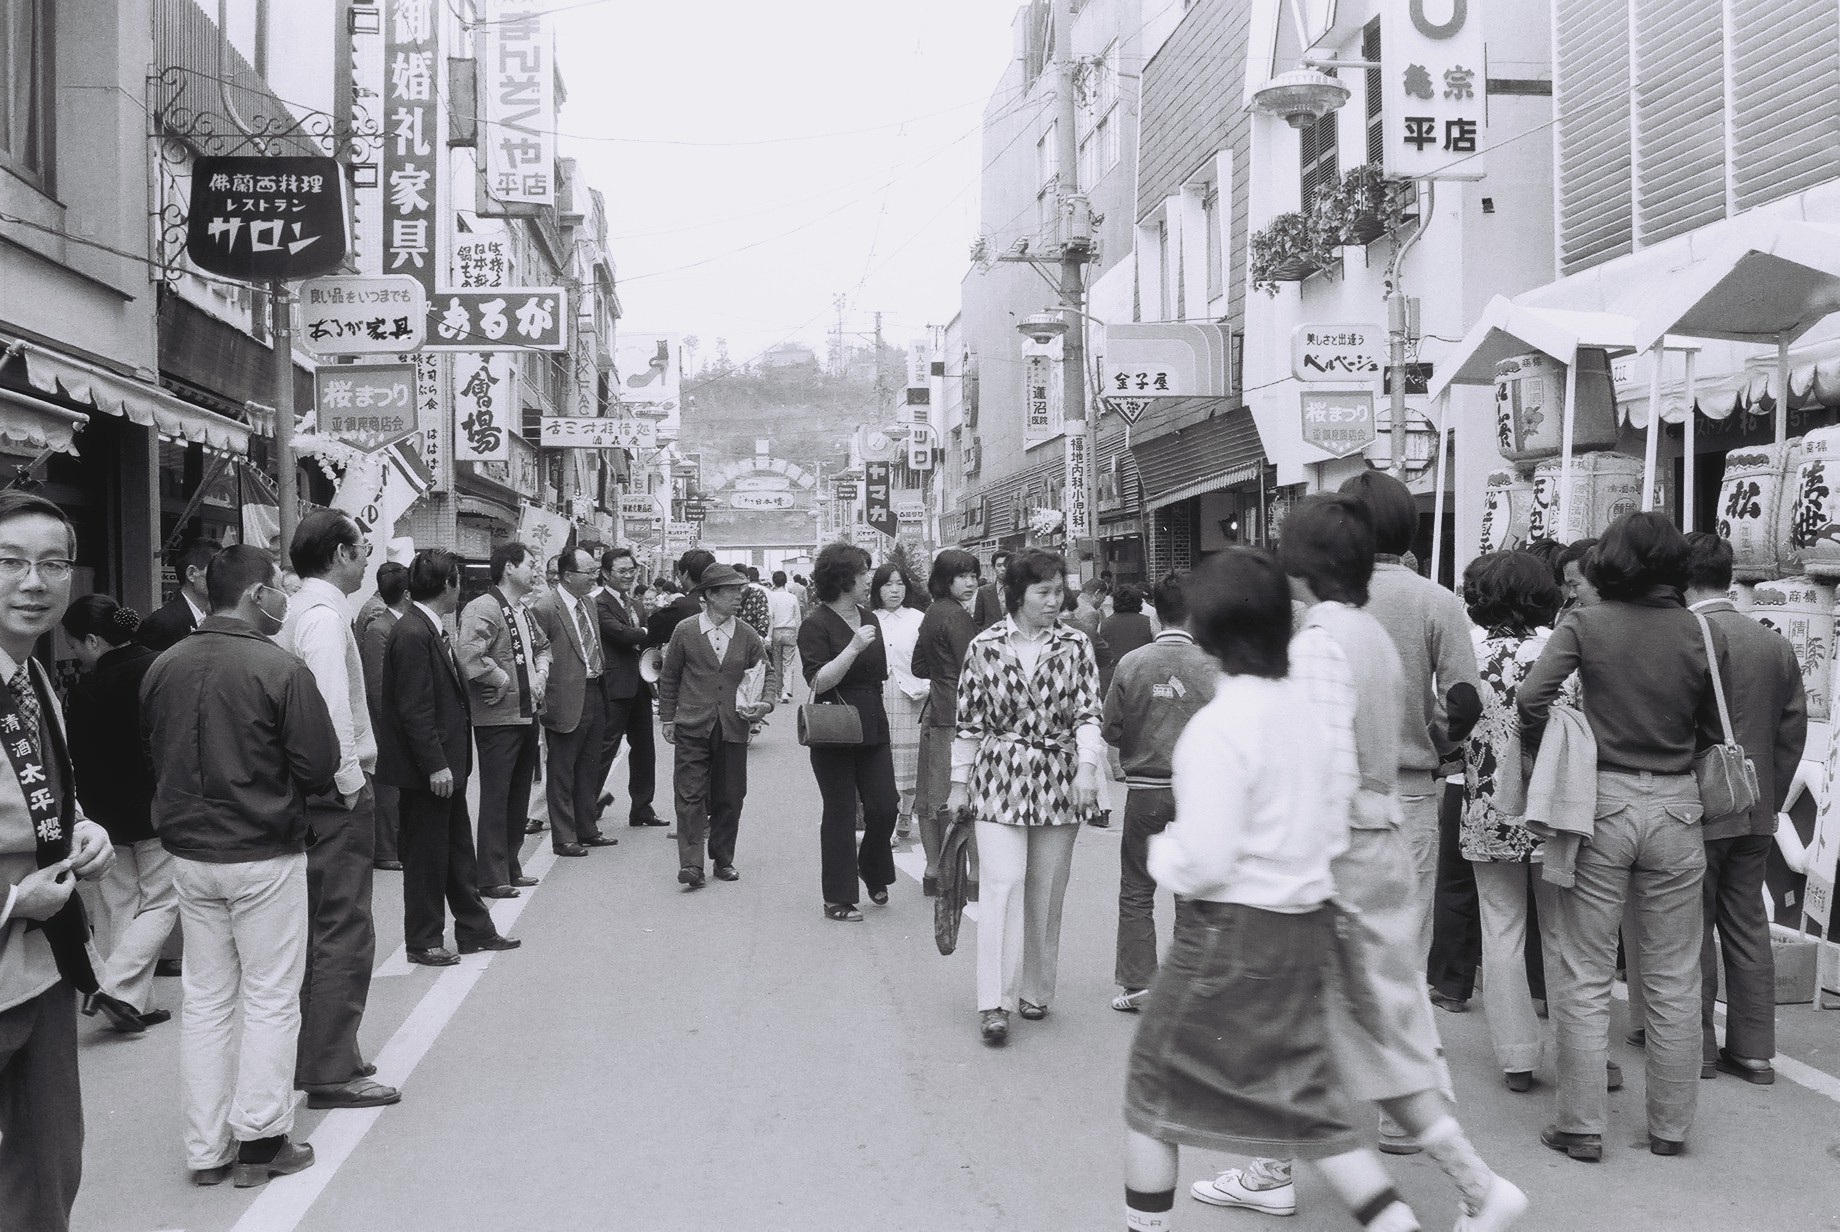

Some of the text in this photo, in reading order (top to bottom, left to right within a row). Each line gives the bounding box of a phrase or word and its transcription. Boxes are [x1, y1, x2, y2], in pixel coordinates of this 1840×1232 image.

[1403, 116, 1477, 152] 平店
[208, 173, 324, 193] 佛蘭西料理
[496, 172, 547, 196] 平店
[226, 198, 306, 212] レストラン
[207, 217, 322, 256] サロン
[310, 287, 411, 305] 良い品をいつまでも
[308, 315, 414, 342] あるが家具
[437, 297, 555, 341] あるが
[1306, 332, 1365, 346] 美しさと出逢う
[1114, 371, 1169, 391] 金子屋
[322, 379, 409, 409] 桜まつり
[1305, 401, 1369, 423] 桜まつり
[868, 464, 888, 522] ヤマカ
[1069, 437, 1086, 528] 福地内科小児科
